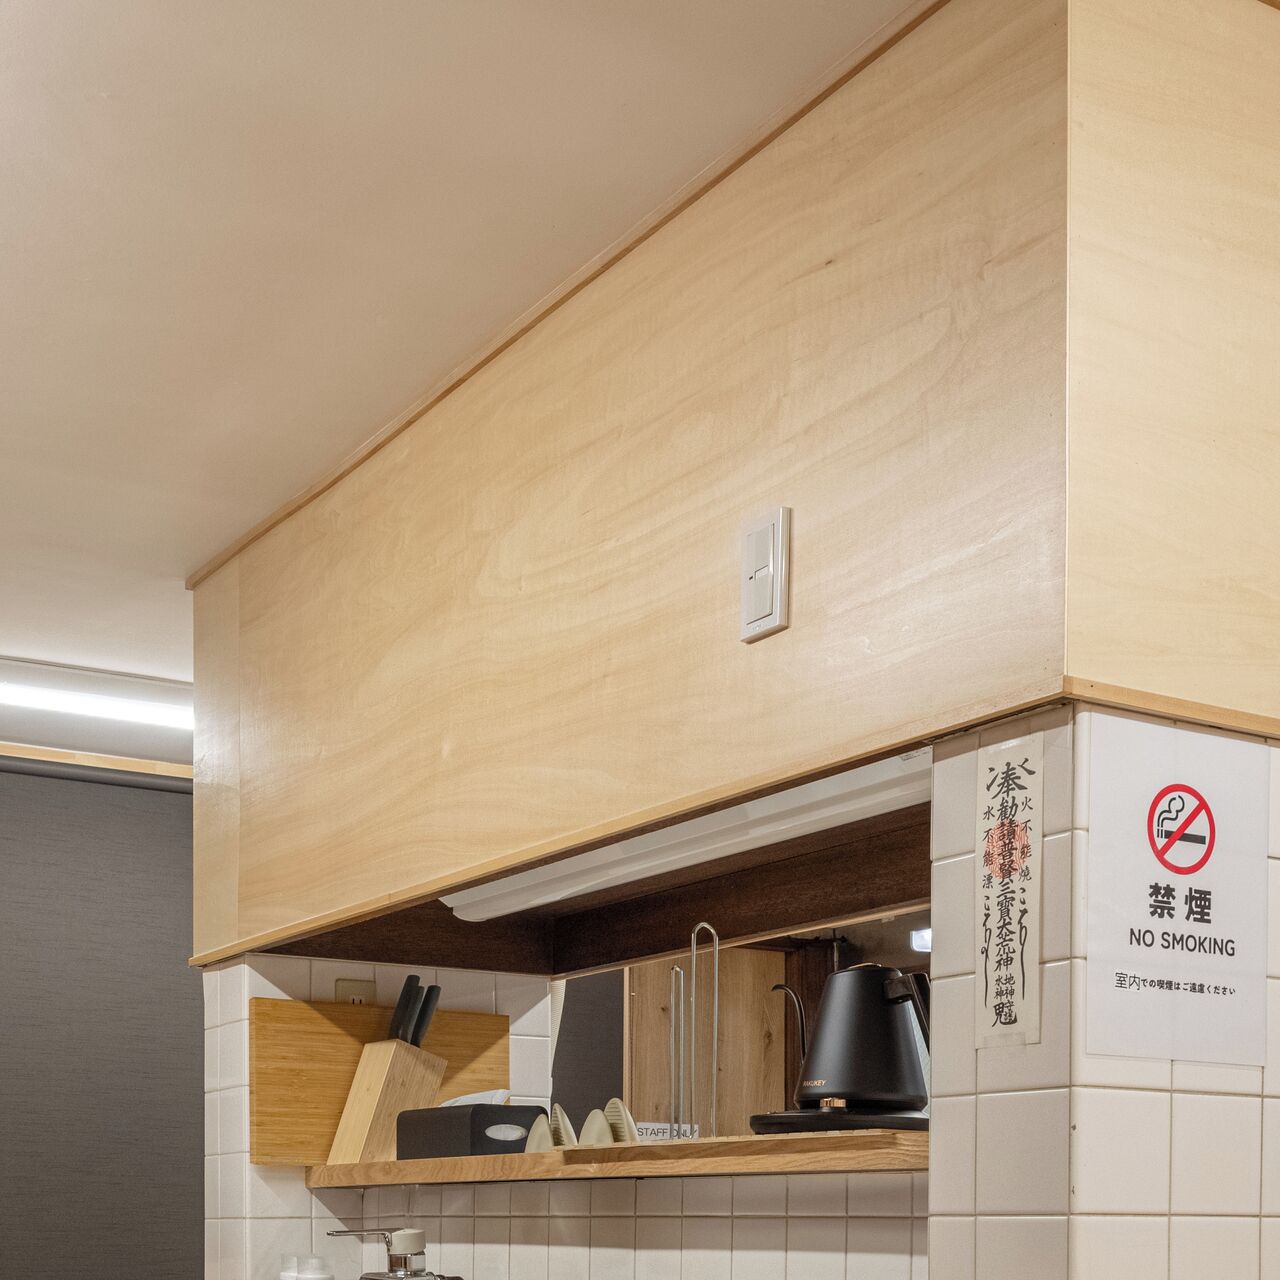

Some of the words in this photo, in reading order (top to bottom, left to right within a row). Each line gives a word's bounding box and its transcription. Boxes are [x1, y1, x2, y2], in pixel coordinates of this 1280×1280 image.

[1148, 882, 1212, 924] 禁煙
[1129, 927, 1155, 948] NO
[1160, 931, 1235, 957] SMOKING
[1114, 972, 1236, 996] 室内での喫煙はご遠慮ください
[637, 1127, 669, 1138] STAFF
